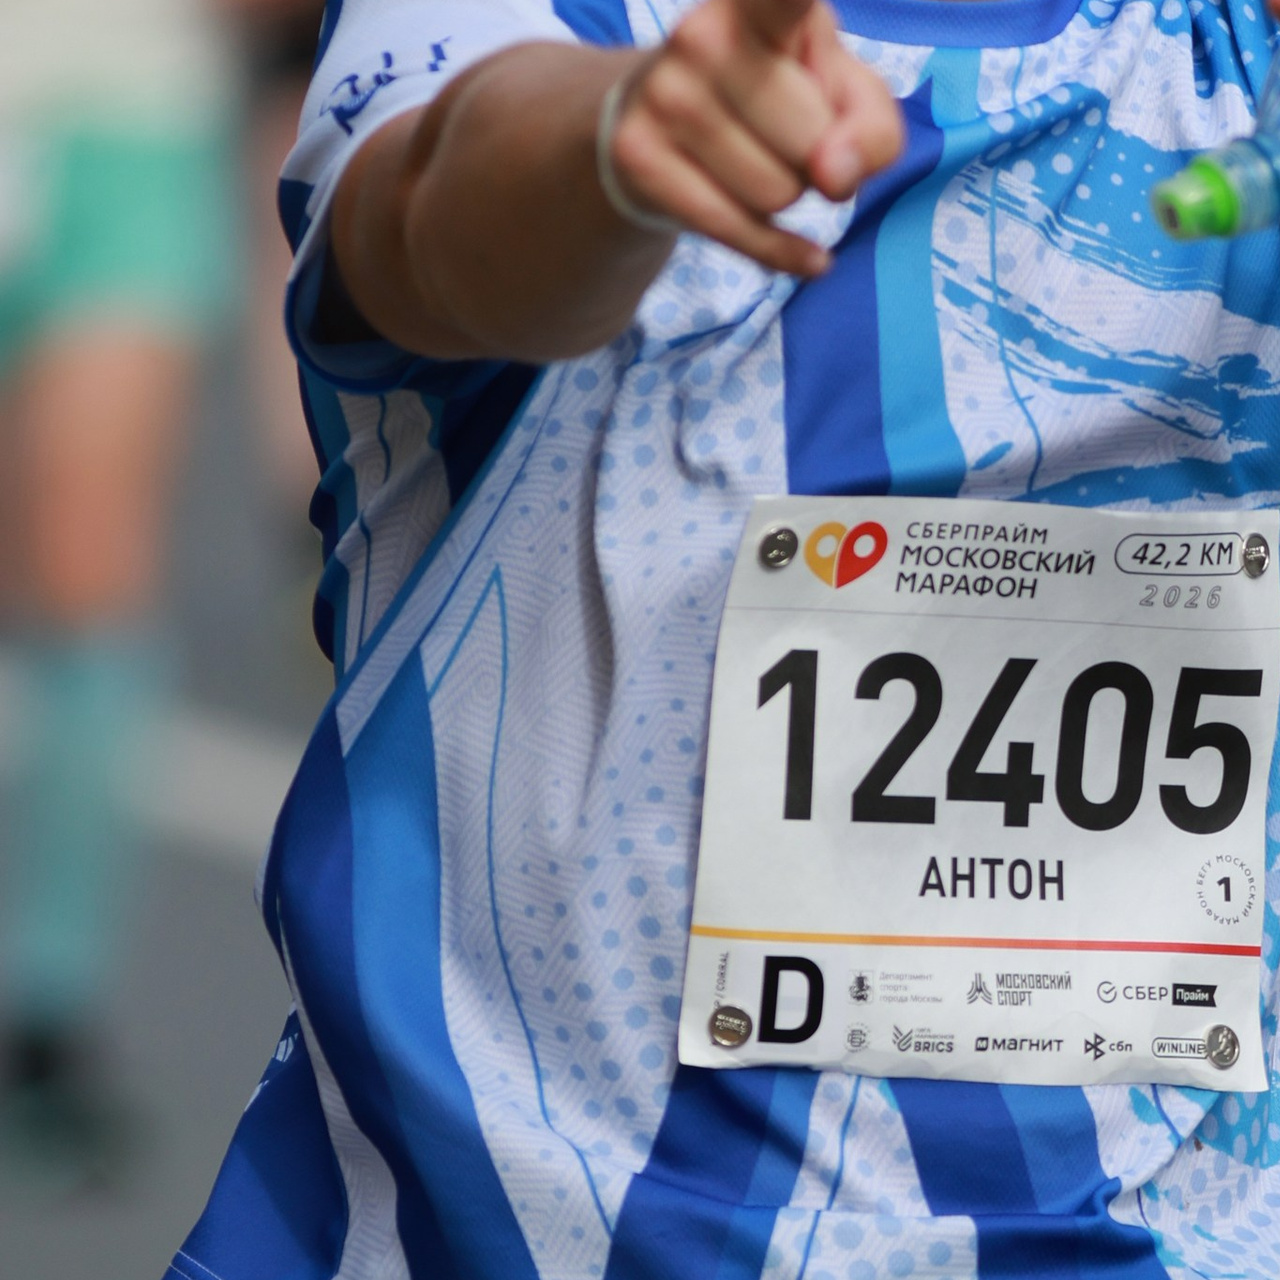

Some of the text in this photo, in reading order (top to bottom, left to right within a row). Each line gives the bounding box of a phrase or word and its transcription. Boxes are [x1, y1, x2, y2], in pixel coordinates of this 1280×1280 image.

[906, 521, 1048, 545] СБЕРПРАЙМ
[900, 545, 1096, 575] МОСКОВСКИЙ
[1131, 542, 1191, 569] 42,2
[1200, 542, 1234, 566] КМ
[895, 572, 1038, 599] МАРАФОН
[1139, 583, 1222, 609] 2026
[756, 648, 1264, 836] 12405
[918, 856, 1066, 902] АНТОН
[1215, 854, 1256, 918] МОСКОВСКИЙ
[1216, 876, 1231, 902] 1
[715, 952, 729, 991] CORRAL
[995, 971, 1072, 990] МОСКОВСКИЙ
[757, 955, 824, 1044] D
[997, 991, 1032, 1007] СПОРТ
[1122, 985, 1209, 1003] СБЕР Прайм
[914, 1041, 954, 1053] BRICS
[1109, 1041, 1133, 1052] сбп
[1156, 1042, 1206, 1054] WINLINE
